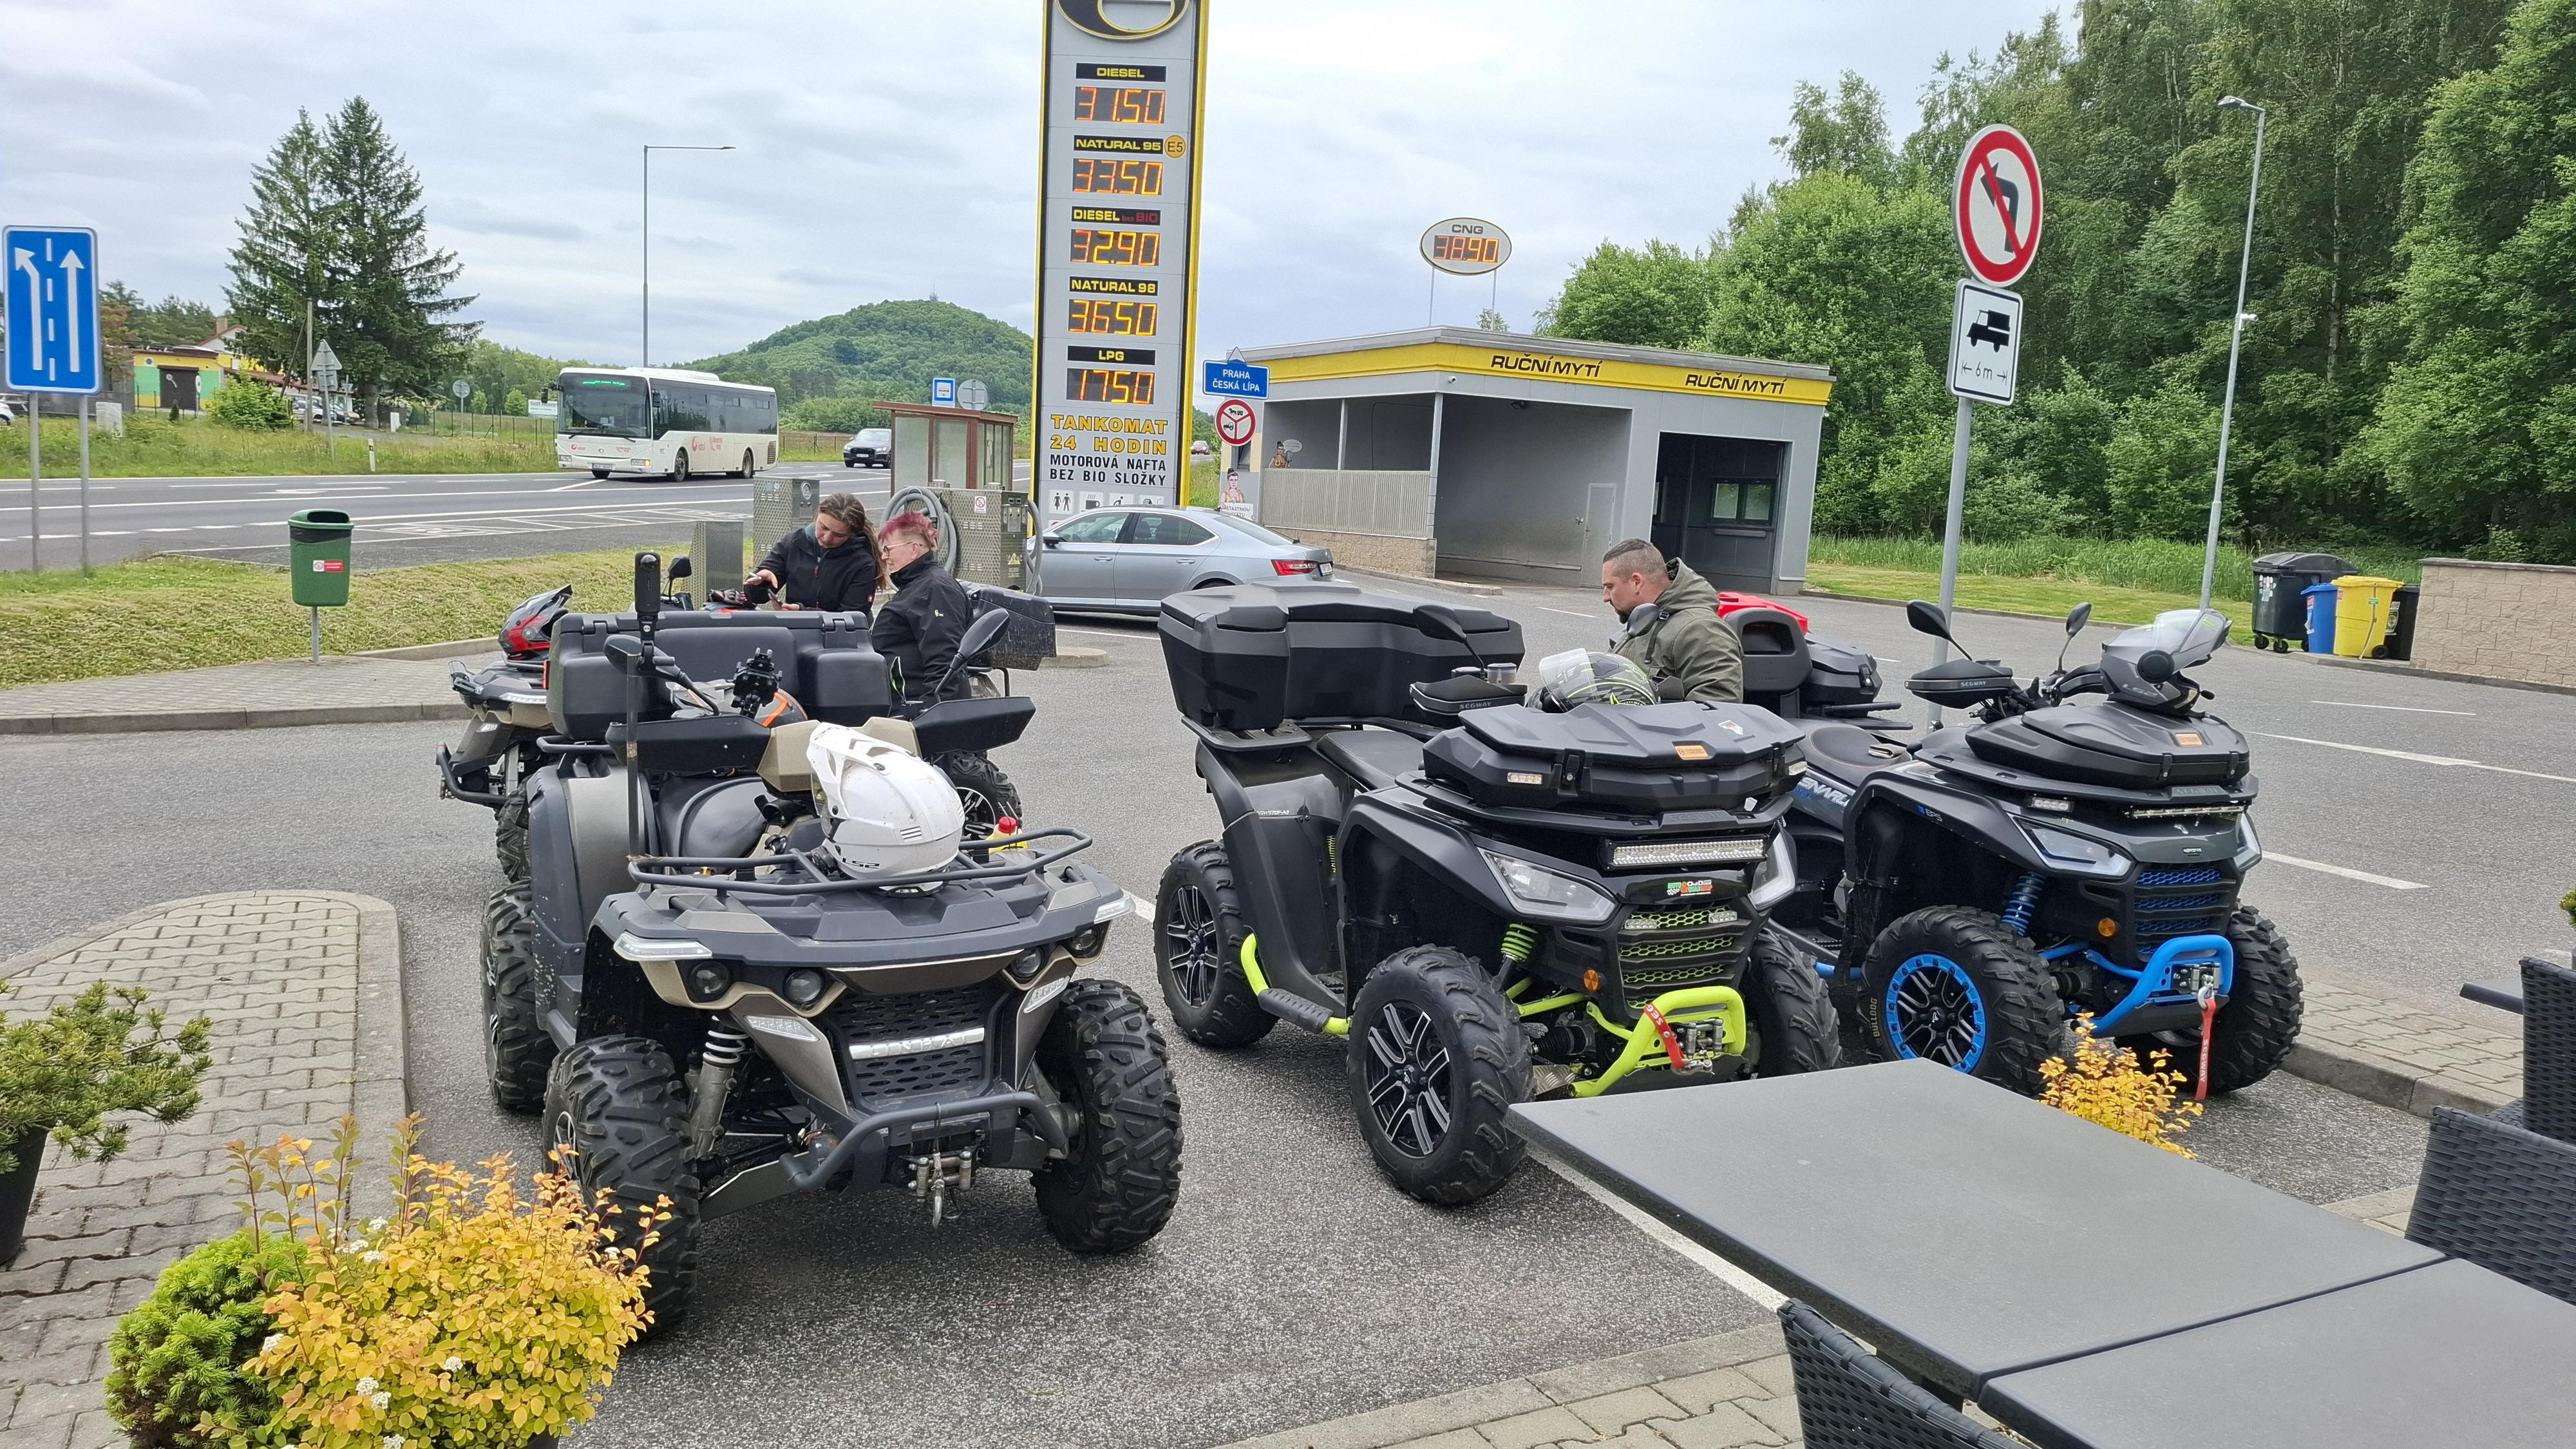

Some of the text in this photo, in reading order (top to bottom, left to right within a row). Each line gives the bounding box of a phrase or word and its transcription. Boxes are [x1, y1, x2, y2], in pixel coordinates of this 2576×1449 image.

[1097, 67, 1144, 79] DIESEL
[1076, 138, 1161, 151] NATURAL 95
[1167, 141, 1184, 153] E5
[1073, 159, 1163, 195] 33.50
[1074, 209, 1120, 221] DIESEL
[1136, 213, 1158, 223] BIO
[1452, 224, 1483, 234] CNG
[1070, 229, 1159, 265] 32.90
[1072, 279, 1156, 293] NATURAL 98
[1099, 350, 1124, 361] LPG
[1491, 353, 1602, 377] RUČNÍ MYTÍ
[1223, 369, 1250, 379] PRAHA
[1213, 379, 1260, 392] ČESKÁ LÍPA
[1685, 372, 1787, 394] RUČNÍ MYTÍ
[1050, 414, 1168, 435] TANKOMAT
[1050, 435, 1166, 455] 24 HODIN
[1050, 454, 1166, 471] MOTOROVÁ NAFTA
[1050, 469, 1166, 486] BEZ BIO SLOŽKY
[2123, 684, 2158, 697] LS2
[1459, 701, 1492, 710] SEGWAY
[1797, 777, 1850, 808] SNARL
[1926, 808, 1942, 822] EPS
[842, 857, 880, 869] LS2
[2200, 1039, 2209, 1082] SEGWAY
